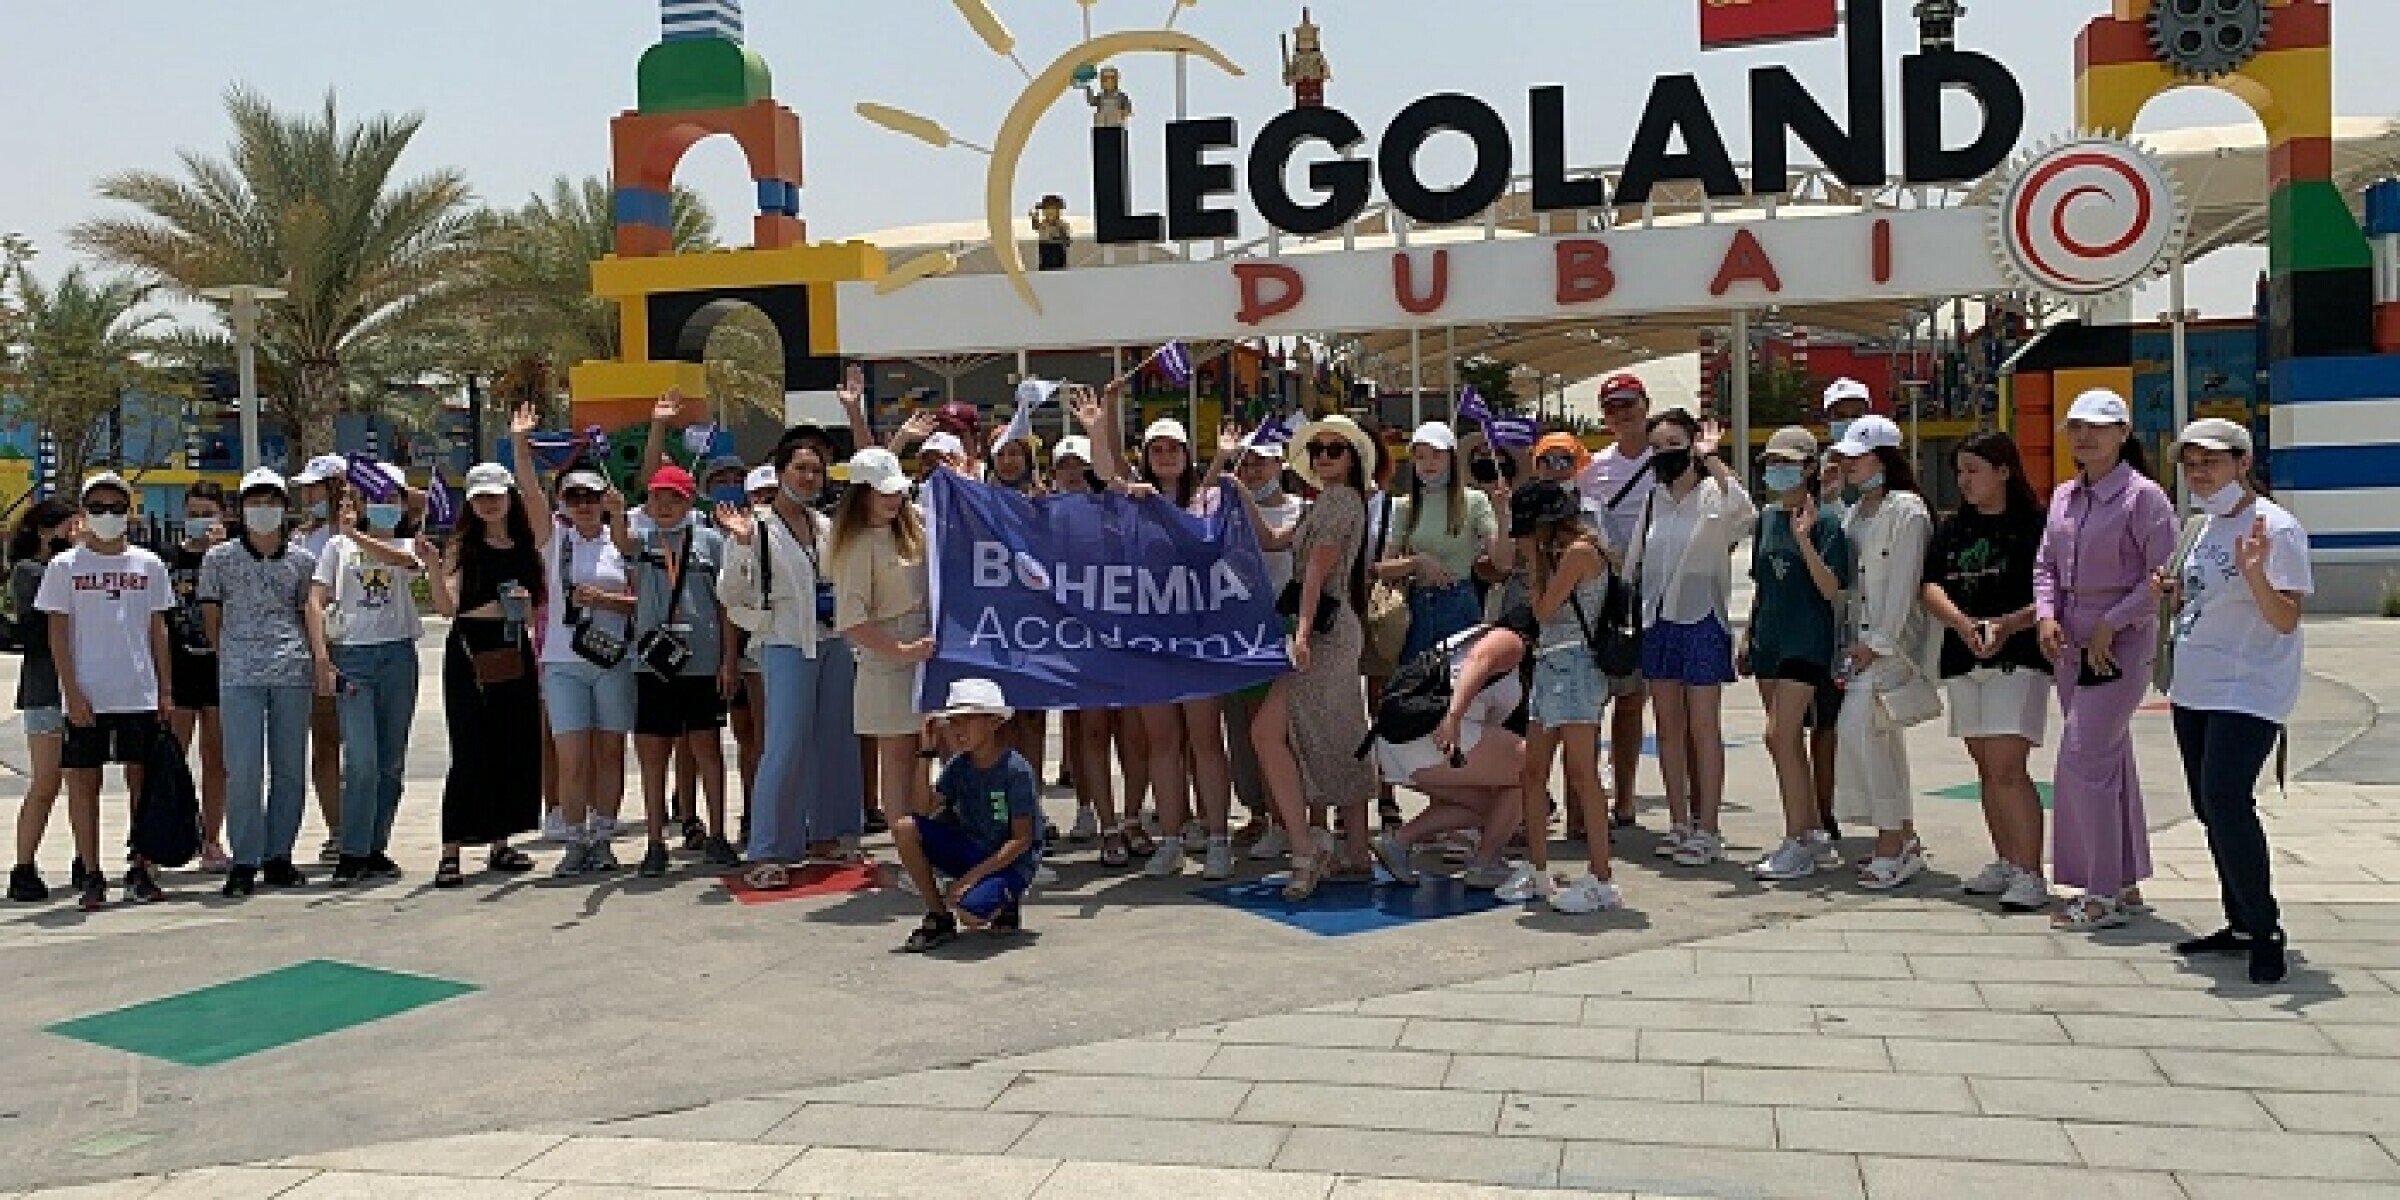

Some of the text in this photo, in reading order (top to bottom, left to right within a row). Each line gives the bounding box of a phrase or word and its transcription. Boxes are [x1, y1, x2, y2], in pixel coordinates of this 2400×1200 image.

[1092, 0, 2024, 244] LEGOLAND
[1231, 217, 1891, 325] DUBAI
[972, 541, 1252, 616] BOHEMIA
